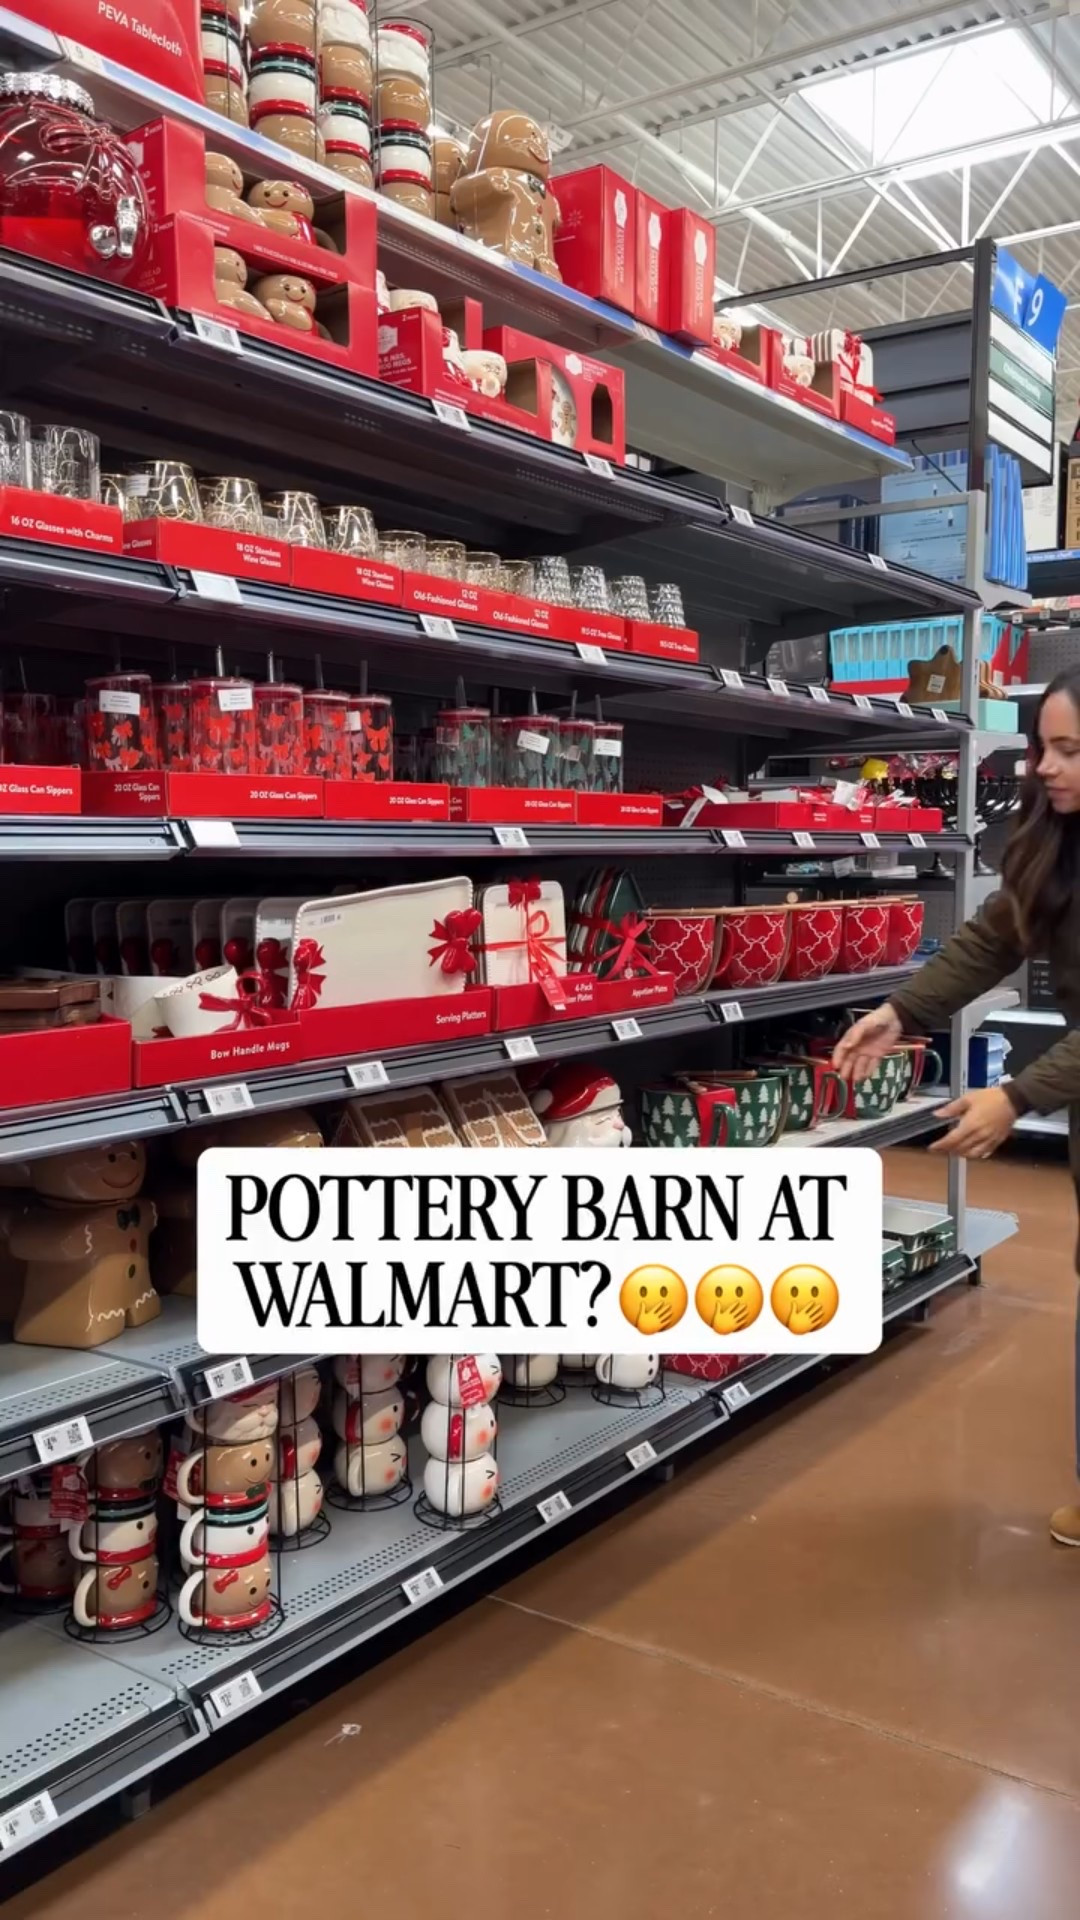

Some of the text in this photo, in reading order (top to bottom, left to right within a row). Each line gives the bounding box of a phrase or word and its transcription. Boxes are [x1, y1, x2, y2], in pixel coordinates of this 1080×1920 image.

[98, 1, 183, 57] PEVA Tablecloth
[1013, 276, 1025, 315] F
[1028, 288, 1044, 326] 9
[10, 515, 114, 544] 16 OZ Glasses with Charms
[131, 538, 153, 549] Glasses
[244, 544, 254, 553] OZ
[254, 545, 281, 559] Stemless
[243, 554, 281, 568] Wine Glasses
[363, 568, 372, 577] OZ
[372, 569, 394, 582] Stemless
[361, 577, 395, 590] Wine Glasses
[413, 590, 478, 611] Old-Fashioned Glasses
[462, 589, 478, 600] 12 OZ
[492, 610, 549, 629] Old-Fashioned Glasses
[540, 610, 549, 619] OZ
[8, 783, 29, 794] Glass
[30, 784, 45, 794] Can
[46, 785, 73, 797] Sippers
[114, 782, 160, 792] 20 OZ Glass Can
[138, 792, 161, 803] Sippers
[250, 790, 318, 802] 20 OZ Glass Can Sippers
[397, 797, 405, 805] OZ
[405, 797, 417, 806] Glass
[417, 797, 427, 806] Can
[426, 797, 444, 807] Sippers
[538, 800, 549, 808] Glass
[556, 801, 572, 810] Sippers
[646, 806, 659, 815] Sippers
[575, 982, 593, 992] 4-Pack
[632, 985, 668, 999] Appetizer Plates
[577, 993, 593, 1002] Plates
[436, 1010, 487, 1024] Serving Platters
[210, 1041, 291, 1060] Bow Handle Mugs
